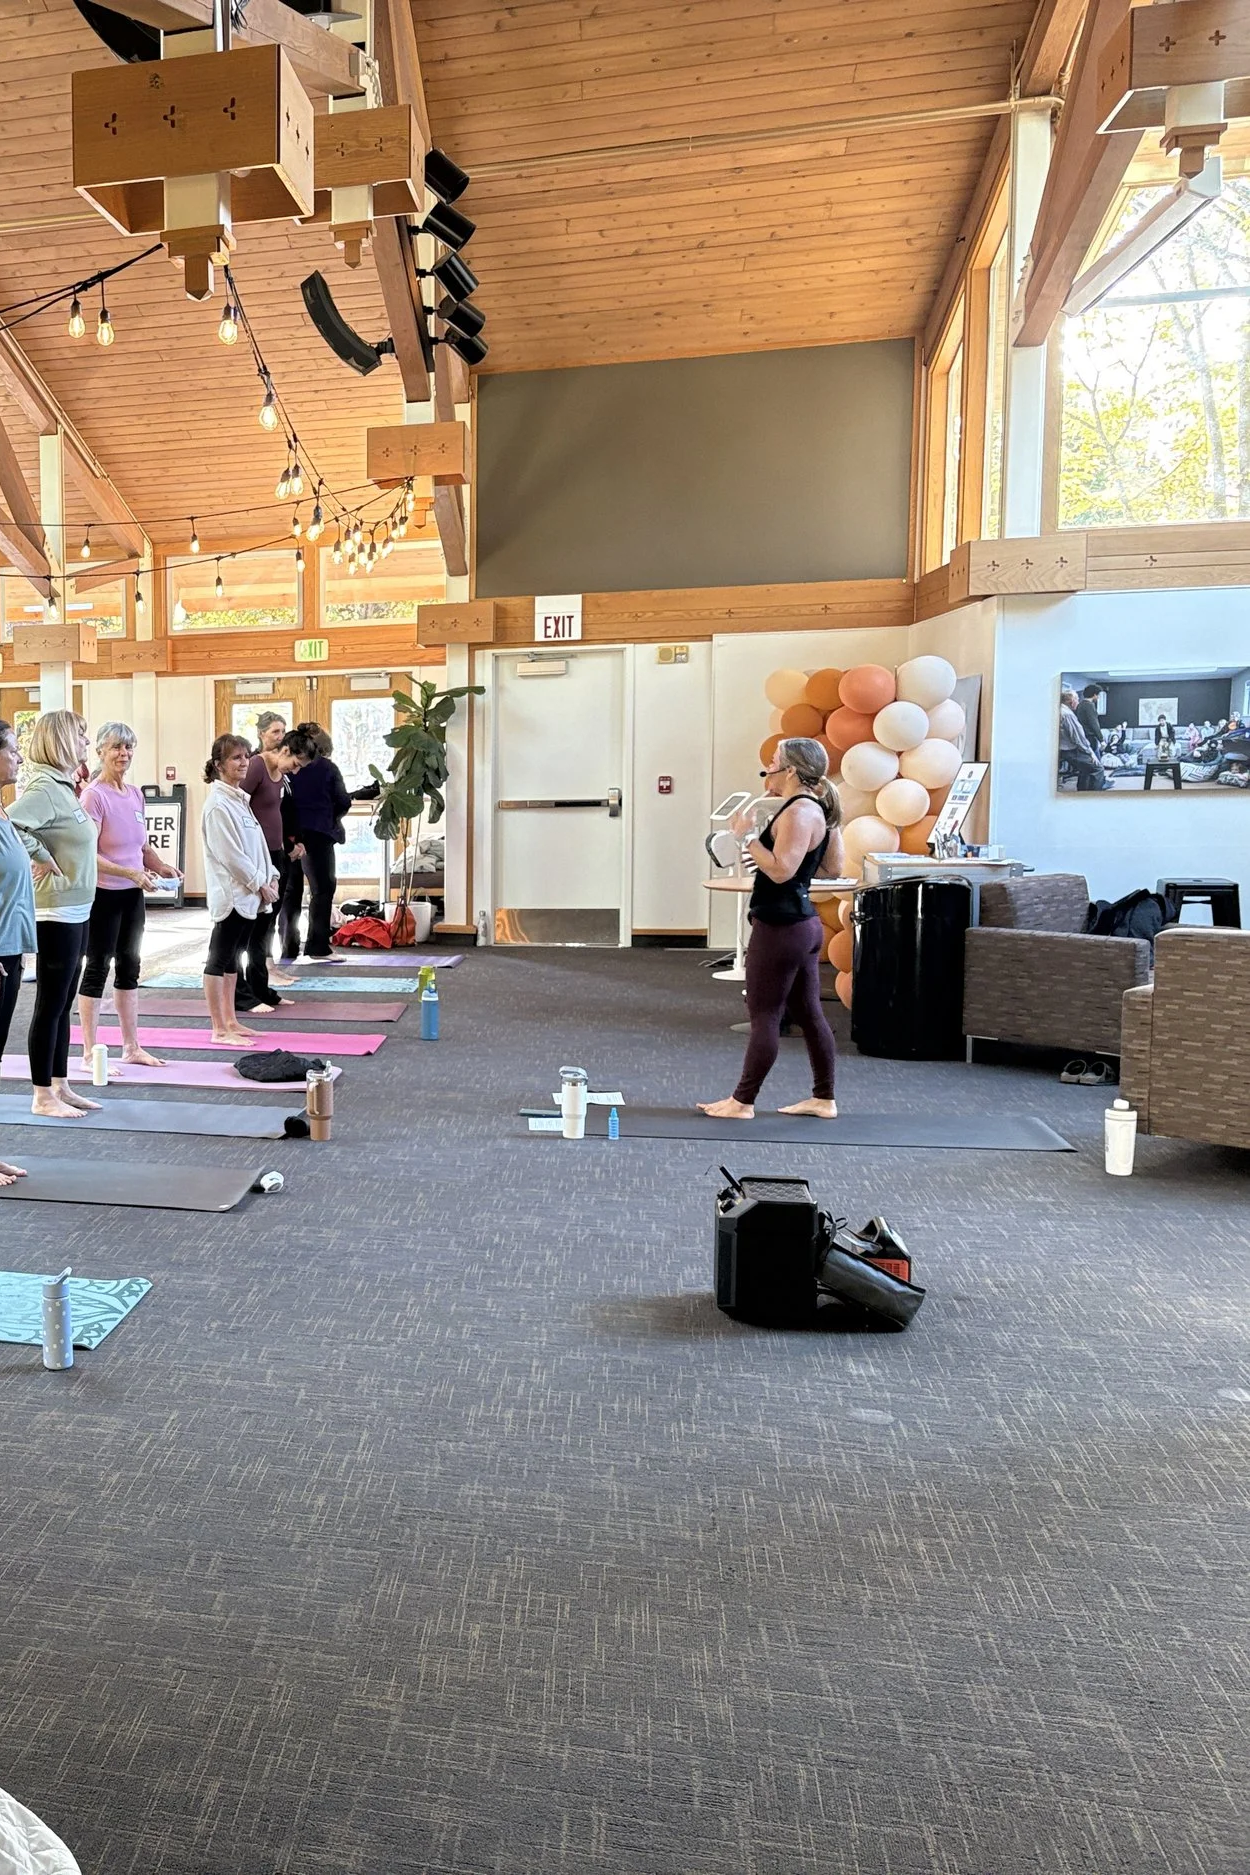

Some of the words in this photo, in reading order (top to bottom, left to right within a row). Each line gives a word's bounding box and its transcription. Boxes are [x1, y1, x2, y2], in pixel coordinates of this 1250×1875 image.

[544, 615, 574, 638] EXIT
[145, 817, 175, 831] TER
[149, 835, 170, 848] RE
